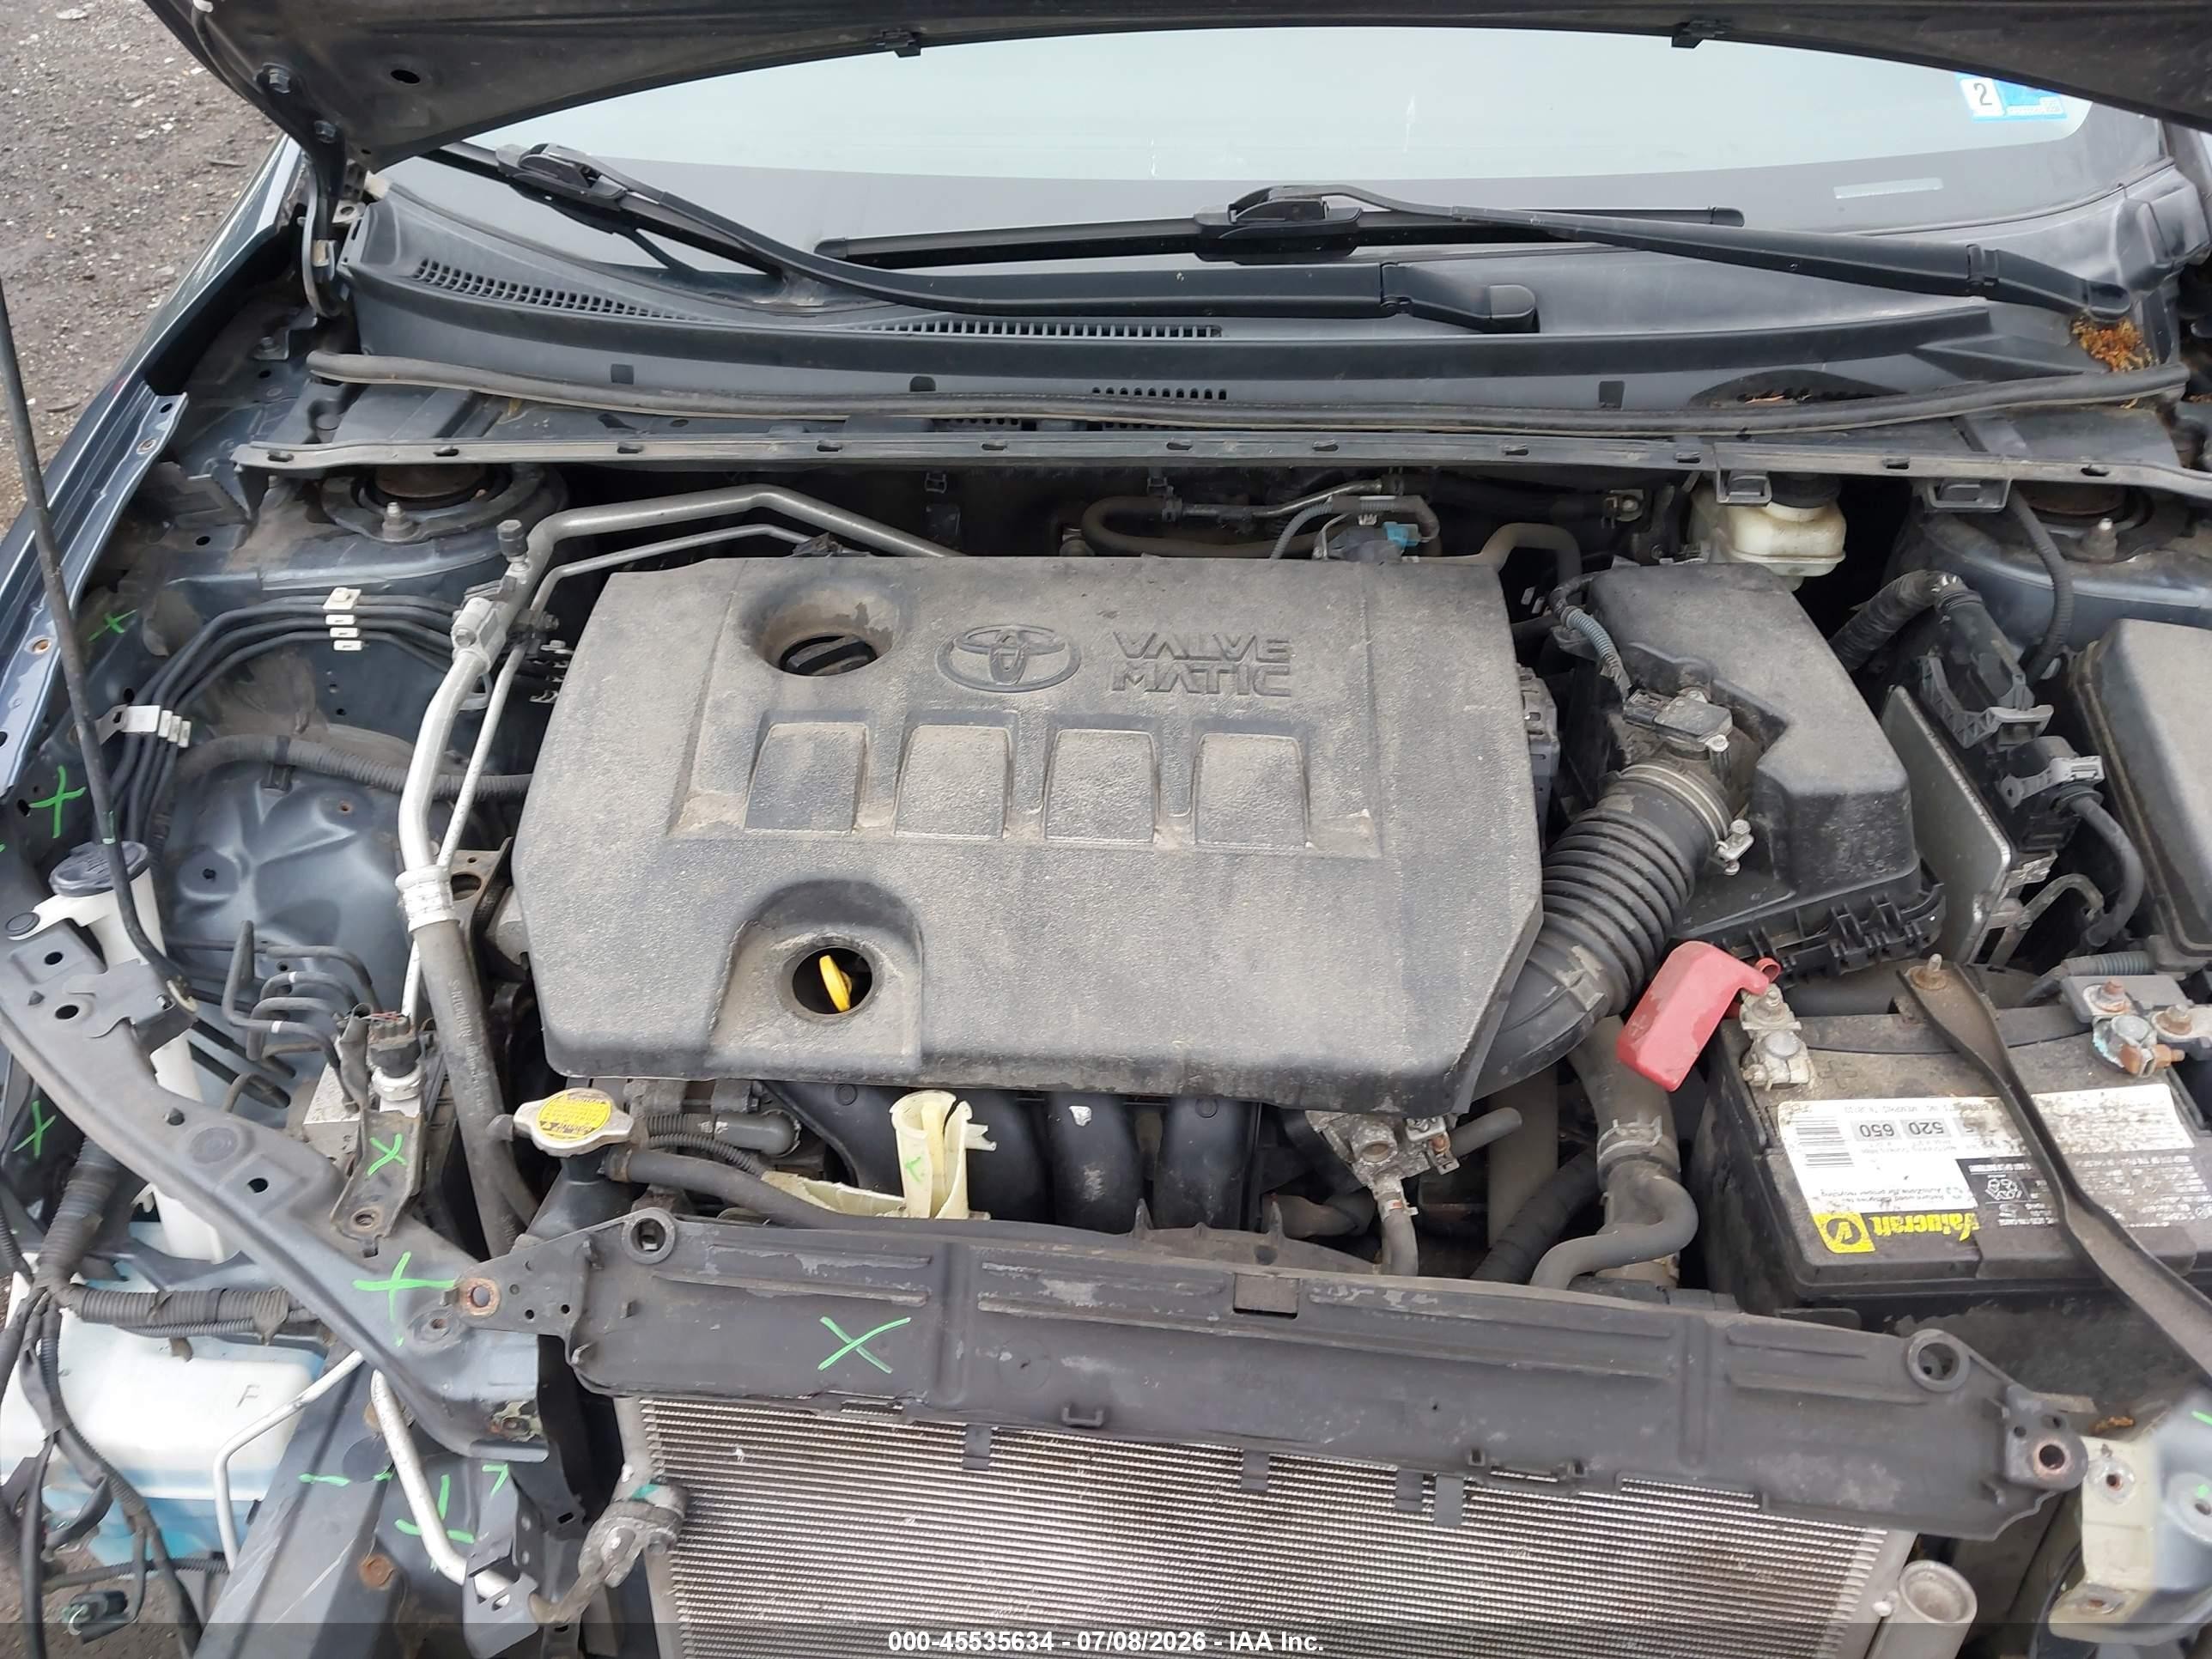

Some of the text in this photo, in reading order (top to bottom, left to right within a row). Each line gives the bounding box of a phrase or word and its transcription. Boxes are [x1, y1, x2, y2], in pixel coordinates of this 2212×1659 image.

[1973, 82, 1993, 106] 2
[1113, 632, 1291, 663] VALVE
[1111, 662, 1292, 697] MATIC
[1859, 1121, 1945, 1138] 520 650
